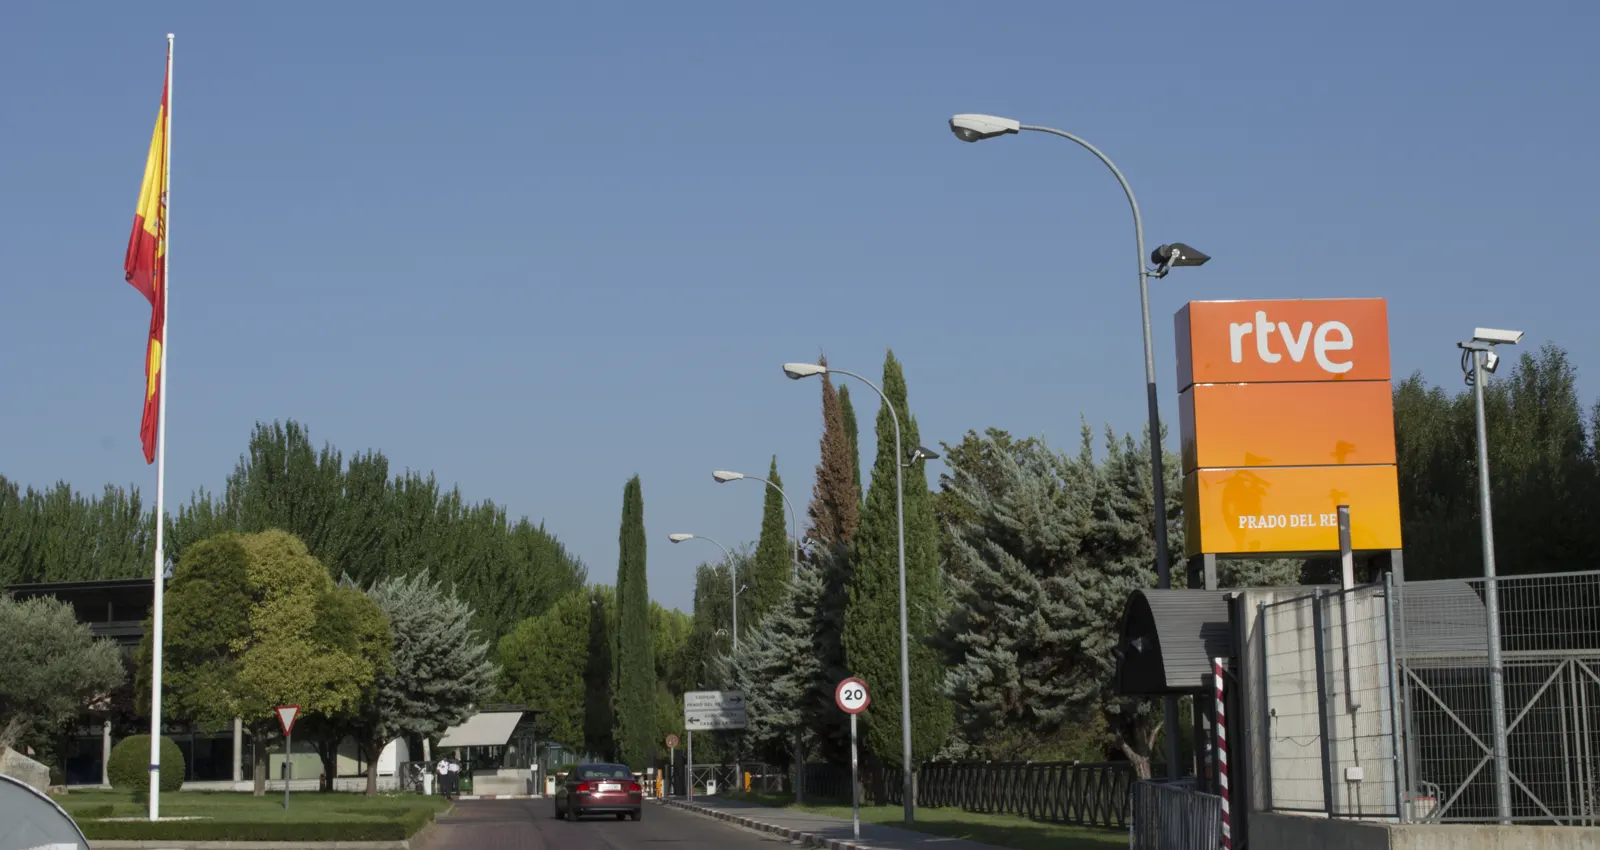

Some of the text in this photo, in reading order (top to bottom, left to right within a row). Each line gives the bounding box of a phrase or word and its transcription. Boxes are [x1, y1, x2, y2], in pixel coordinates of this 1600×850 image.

[1229, 310, 1354, 374] rtve
[1238, 513, 1338, 529] PRADO DEL RE
[844, 689, 863, 701] 20
